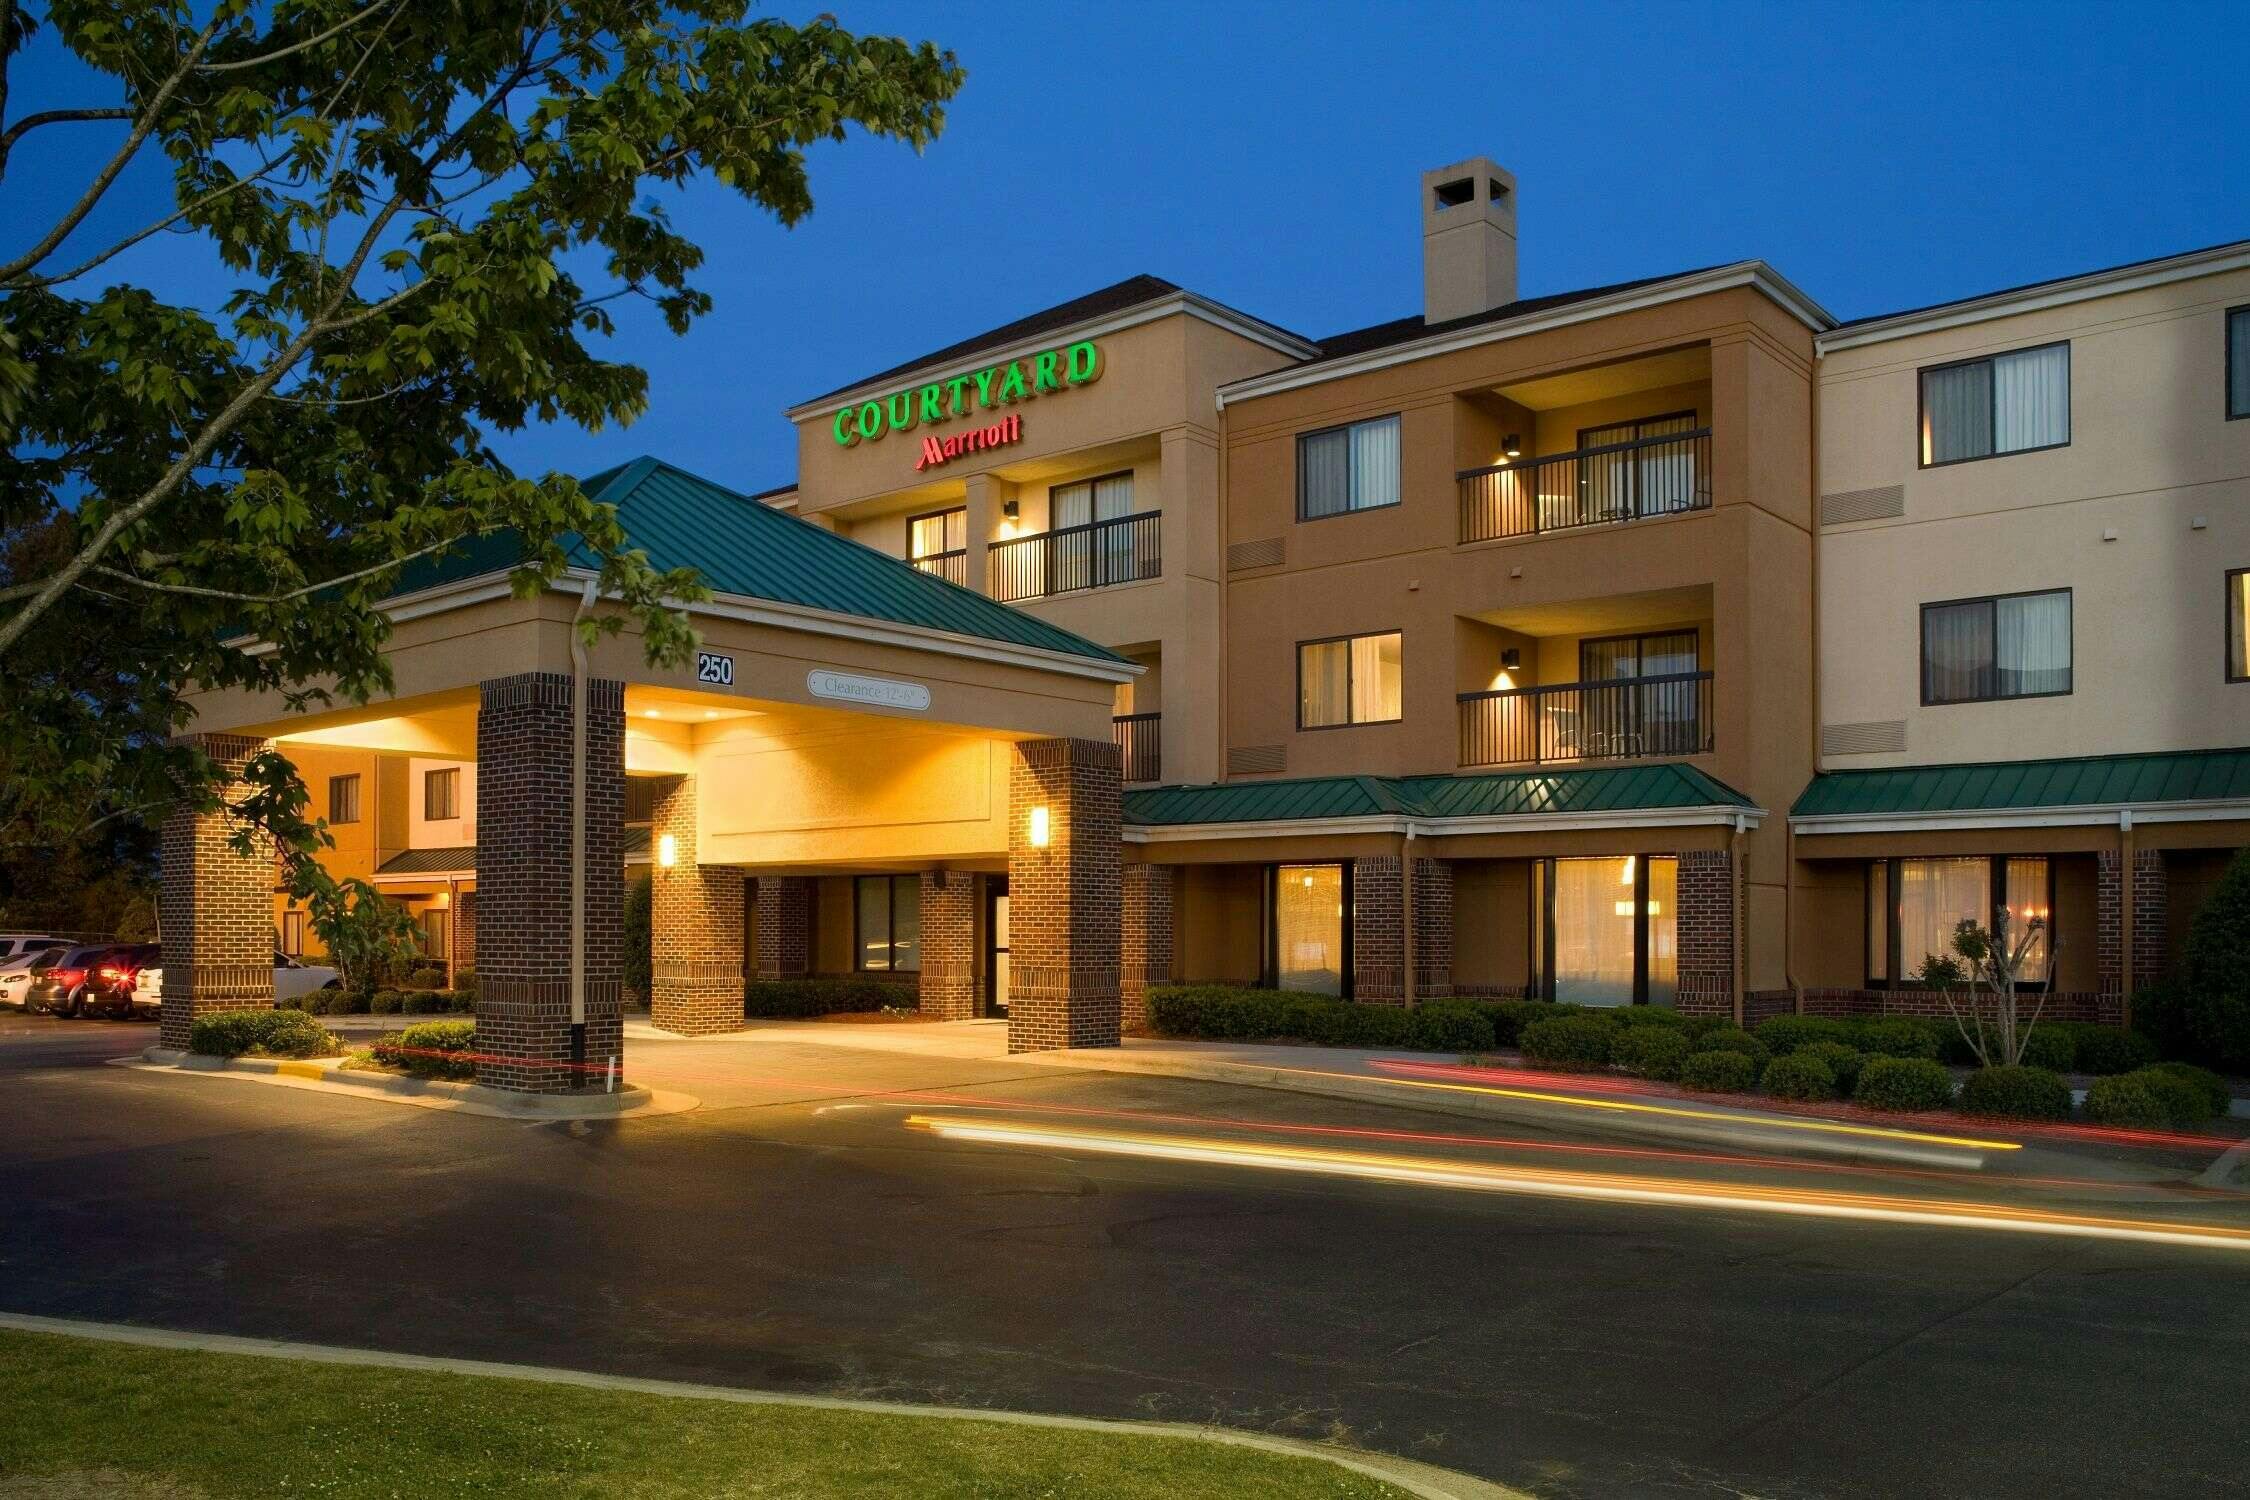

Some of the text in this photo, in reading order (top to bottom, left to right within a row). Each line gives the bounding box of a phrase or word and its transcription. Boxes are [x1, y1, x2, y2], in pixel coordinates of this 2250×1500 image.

[833, 341, 1098, 446] COURTYARD
[913, 413, 1022, 471] Marriott
[699, 655, 733, 684] 250
[824, 677, 882, 698] Clearance
